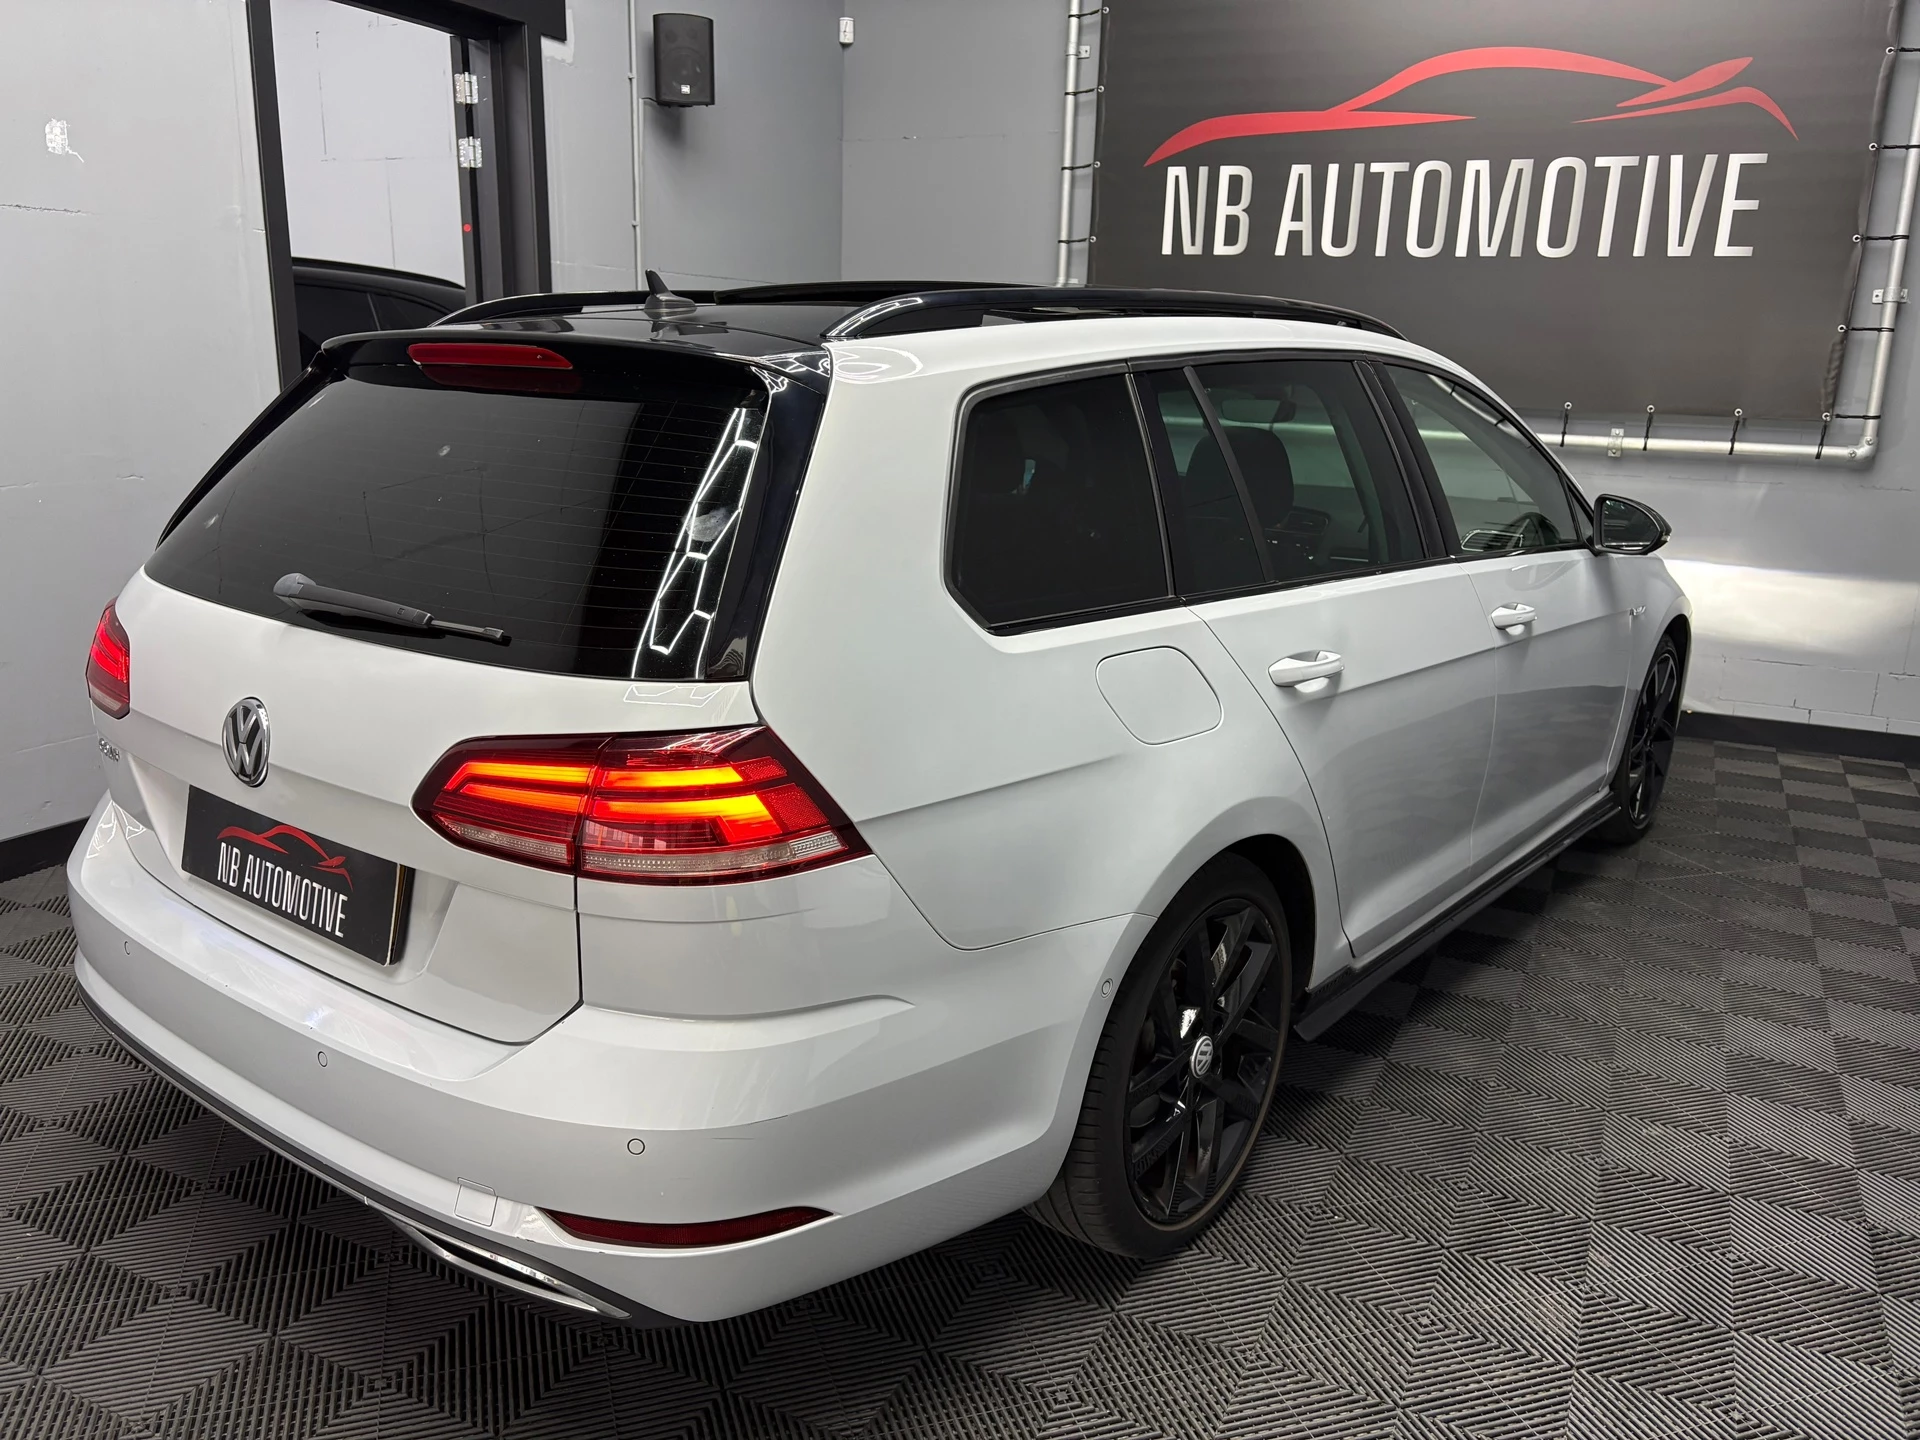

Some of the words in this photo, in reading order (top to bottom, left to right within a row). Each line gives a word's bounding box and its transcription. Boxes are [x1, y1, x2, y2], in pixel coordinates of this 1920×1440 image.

[1162, 164, 1252, 257] NB
[1275, 153, 1768, 258] AUTOMOTIVE
[217, 842, 241, 887] NB
[243, 854, 348, 938] AUTOMOTIVE
